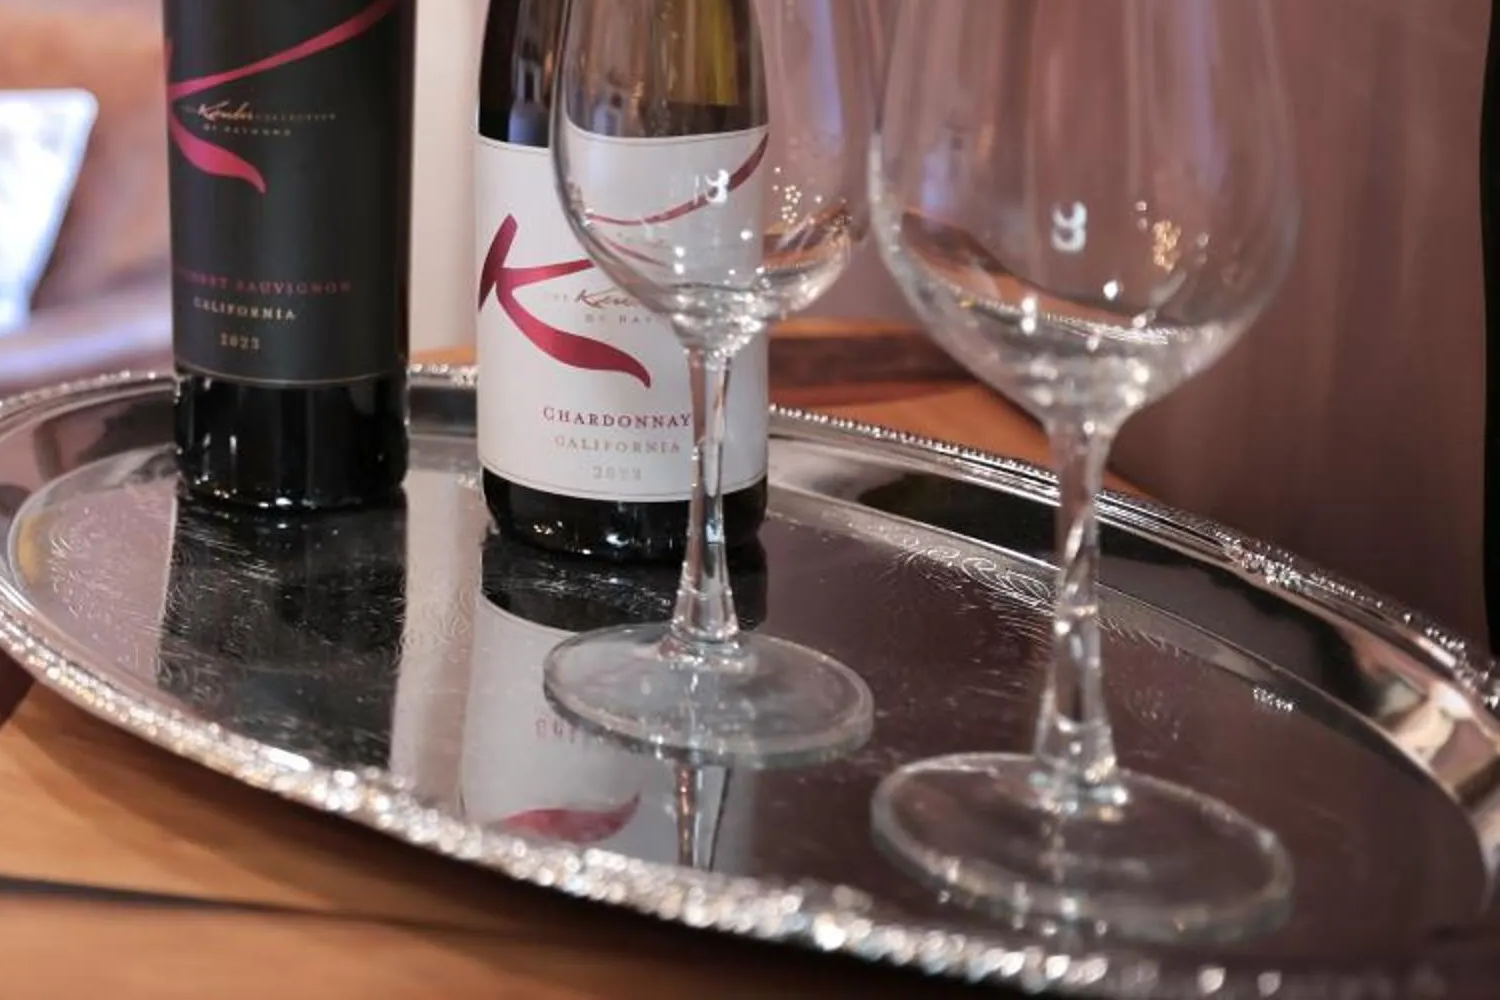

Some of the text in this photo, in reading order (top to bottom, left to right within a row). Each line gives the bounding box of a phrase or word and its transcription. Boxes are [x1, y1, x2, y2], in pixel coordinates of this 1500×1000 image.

[193, 296, 296, 321] CALIFORNIA
[543, 406, 691, 429] CHARDONNAY
[554, 434, 681, 454] CALIFORNIA
